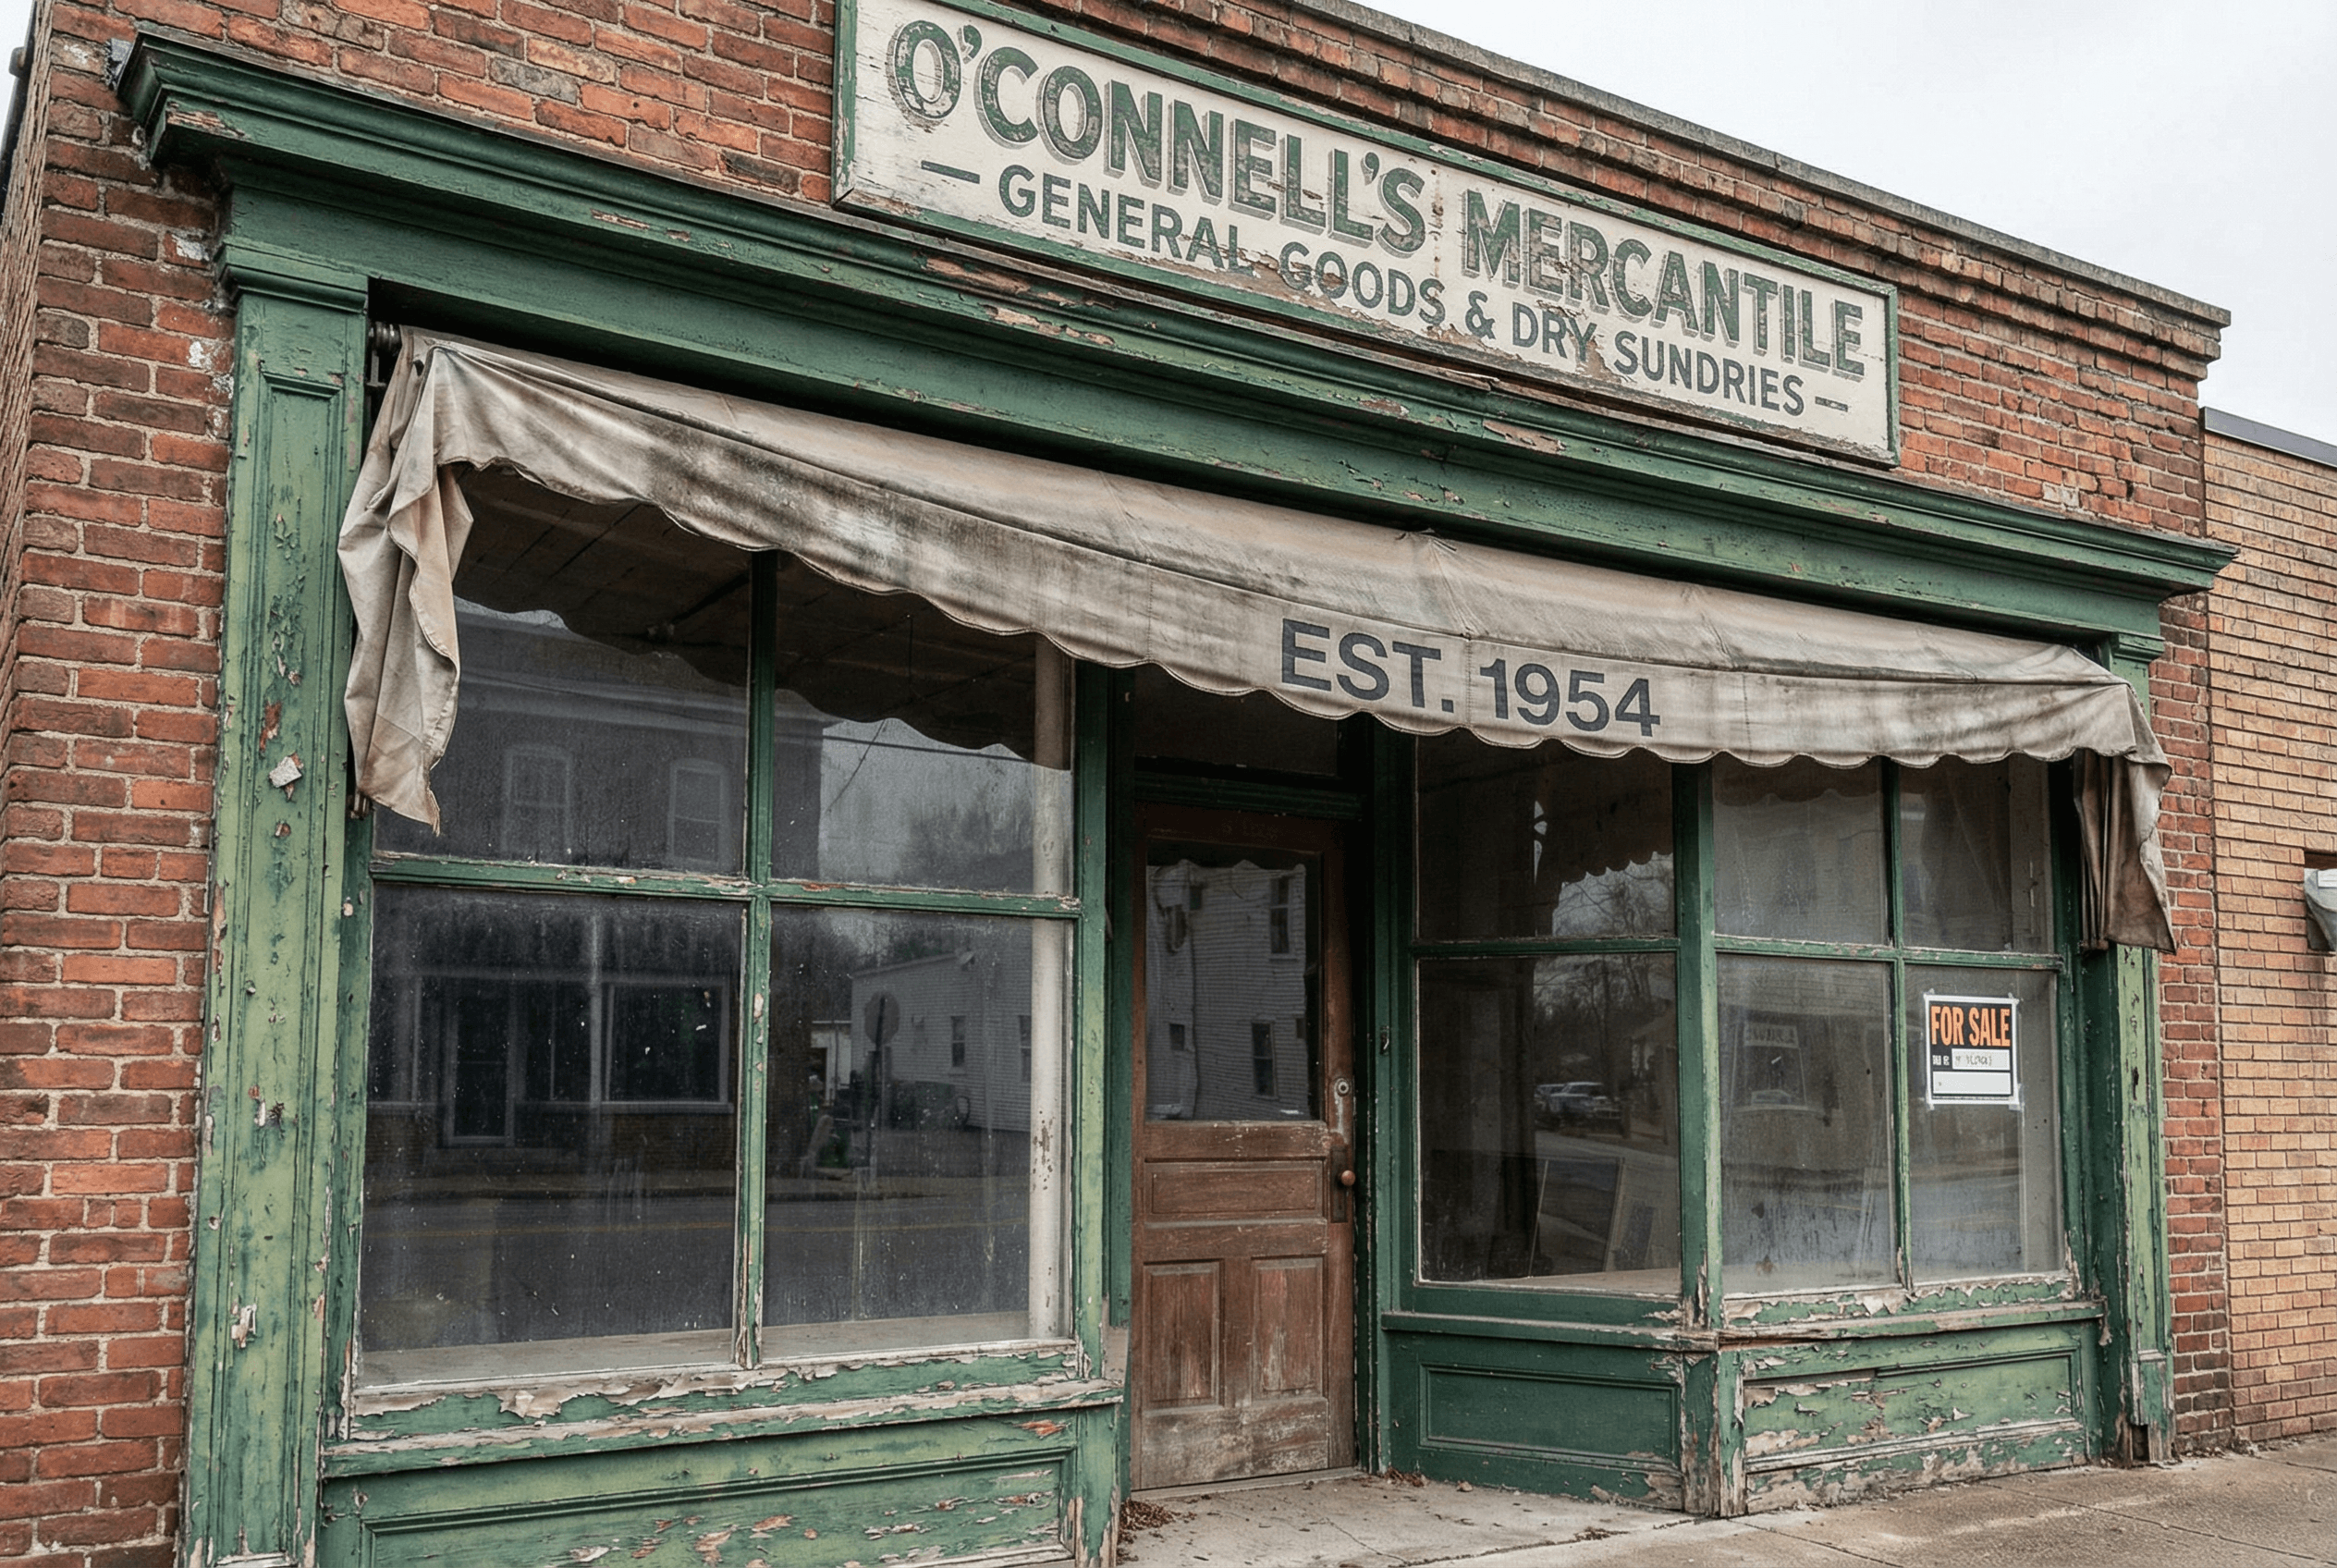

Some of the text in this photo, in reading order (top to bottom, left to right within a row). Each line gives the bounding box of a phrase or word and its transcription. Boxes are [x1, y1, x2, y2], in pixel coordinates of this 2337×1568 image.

[887, 19, 1866, 383] O'CONNELL'S MERCANTILE
[998, 165, 1805, 416] GENERAL GOODS & DRY SUNDRIES
[1282, 619, 1660, 737] EST. 1954
[1930, 1006, 2011, 1047] FOR SALE
